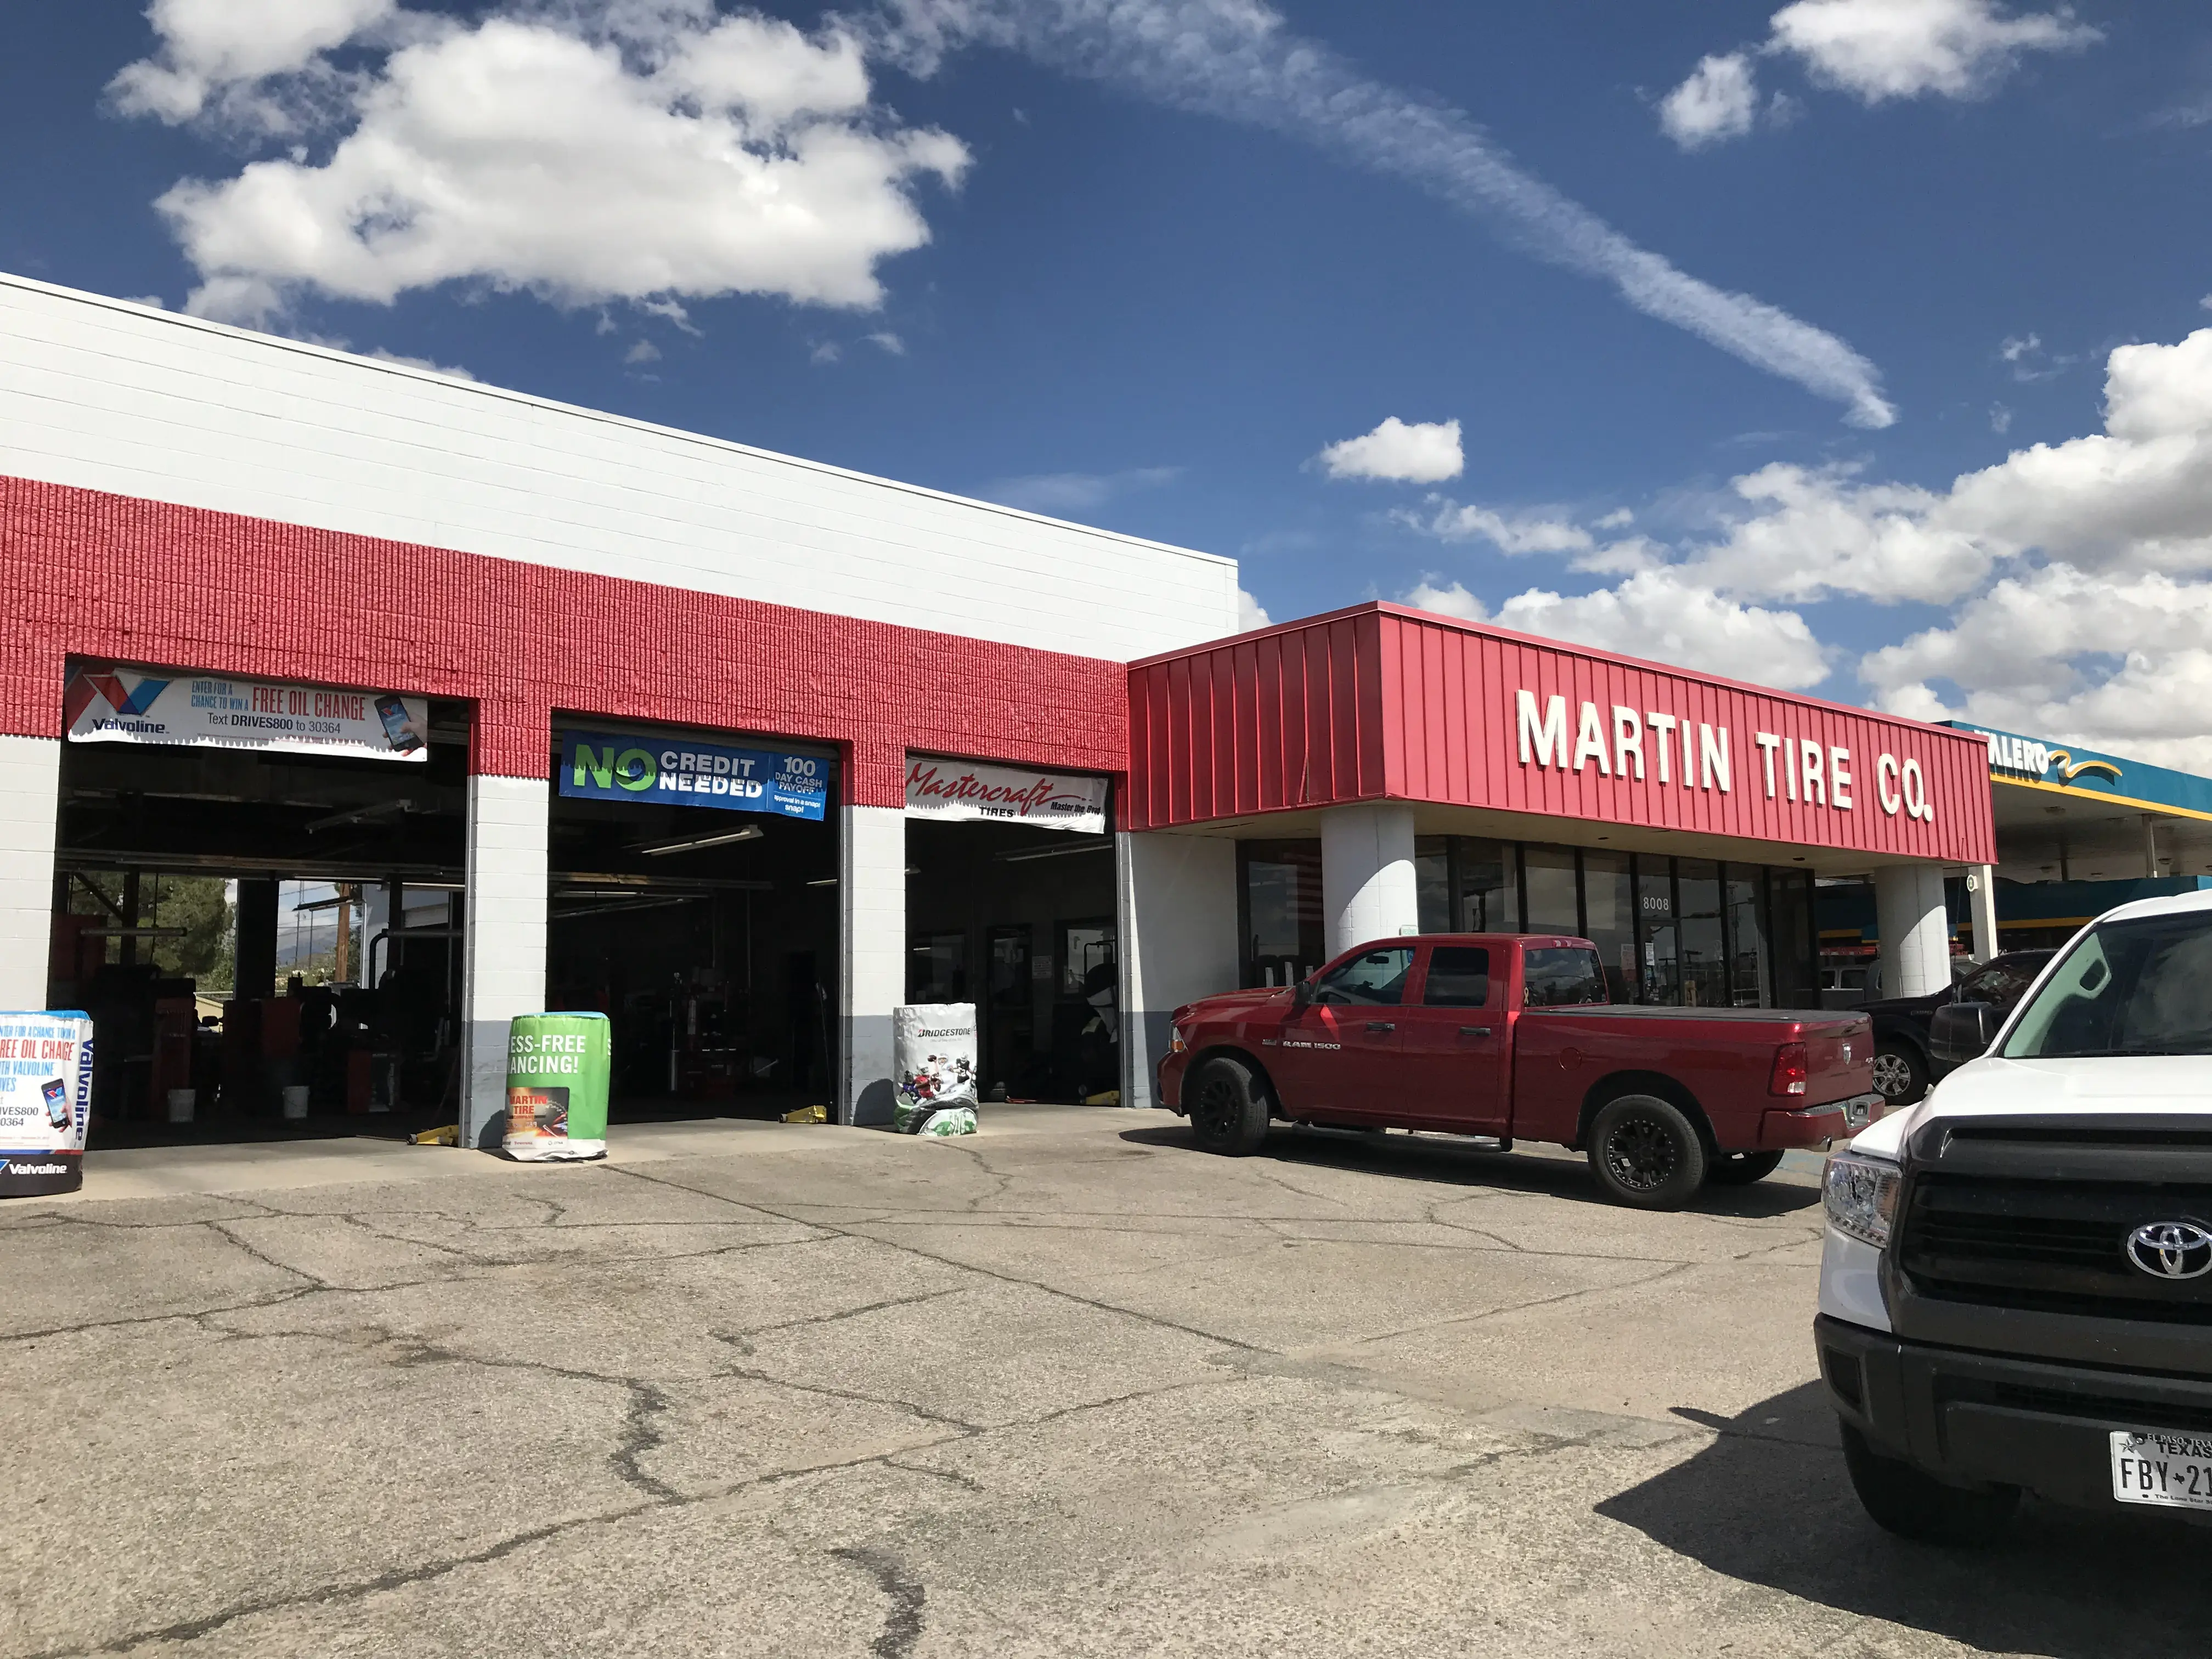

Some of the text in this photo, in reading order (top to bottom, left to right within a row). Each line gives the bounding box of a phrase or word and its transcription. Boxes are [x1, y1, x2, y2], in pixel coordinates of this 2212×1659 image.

[191, 680, 233, 696] ENTER FOR A
[191, 695, 249, 712] CHANCE TO WIN A
[252, 686, 365, 721] FREE OIL CHANGE
[92, 718, 166, 734] Valvoline
[207, 713, 341, 734] Text DRIVES800 to 30364
[1516, 689, 1933, 822] MARTIN TIRE CO.
[1980, 730, 2049, 775] ALERO
[574, 744, 755, 792] NO CREDIT
[783, 757, 816, 776] 100
[659, 771, 763, 798] NEEDED
[775, 771, 822, 788] DAY CASH
[779, 781, 816, 795] PAYOFF
[905, 761, 1061, 816] Mastercraft
[774, 794, 794, 804] approval
[804, 800, 821, 809] snap!
[785, 804, 804, 814] snap!
[1050, 801, 1074, 812] Master
[1074, 804, 1086, 813] the
[979, 805, 1014, 817] TIRES
[1643, 896, 1669, 911] 8008
[15, 1025, 26, 1037] FOR
[27, 1026, 32, 1037] A
[917, 1028, 971, 1037] BRIDGESTONE
[21, 1039, 37, 1059] OIL
[511, 1035, 586, 1053] ESS-FREE
[1283, 1040, 1312, 1048] RAM
[13, 1060, 54, 1076] VALVOLINE
[75, 1039, 94, 1141] Valvoline
[514, 1105, 535, 1114] TIRE
[0, 1117, 25, 1127] 0364
[9, 1163, 67, 1175] Valvoline
[2147, 1432, 2158, 1442] EL
[2156, 1440, 2212, 1459] TEXAS
